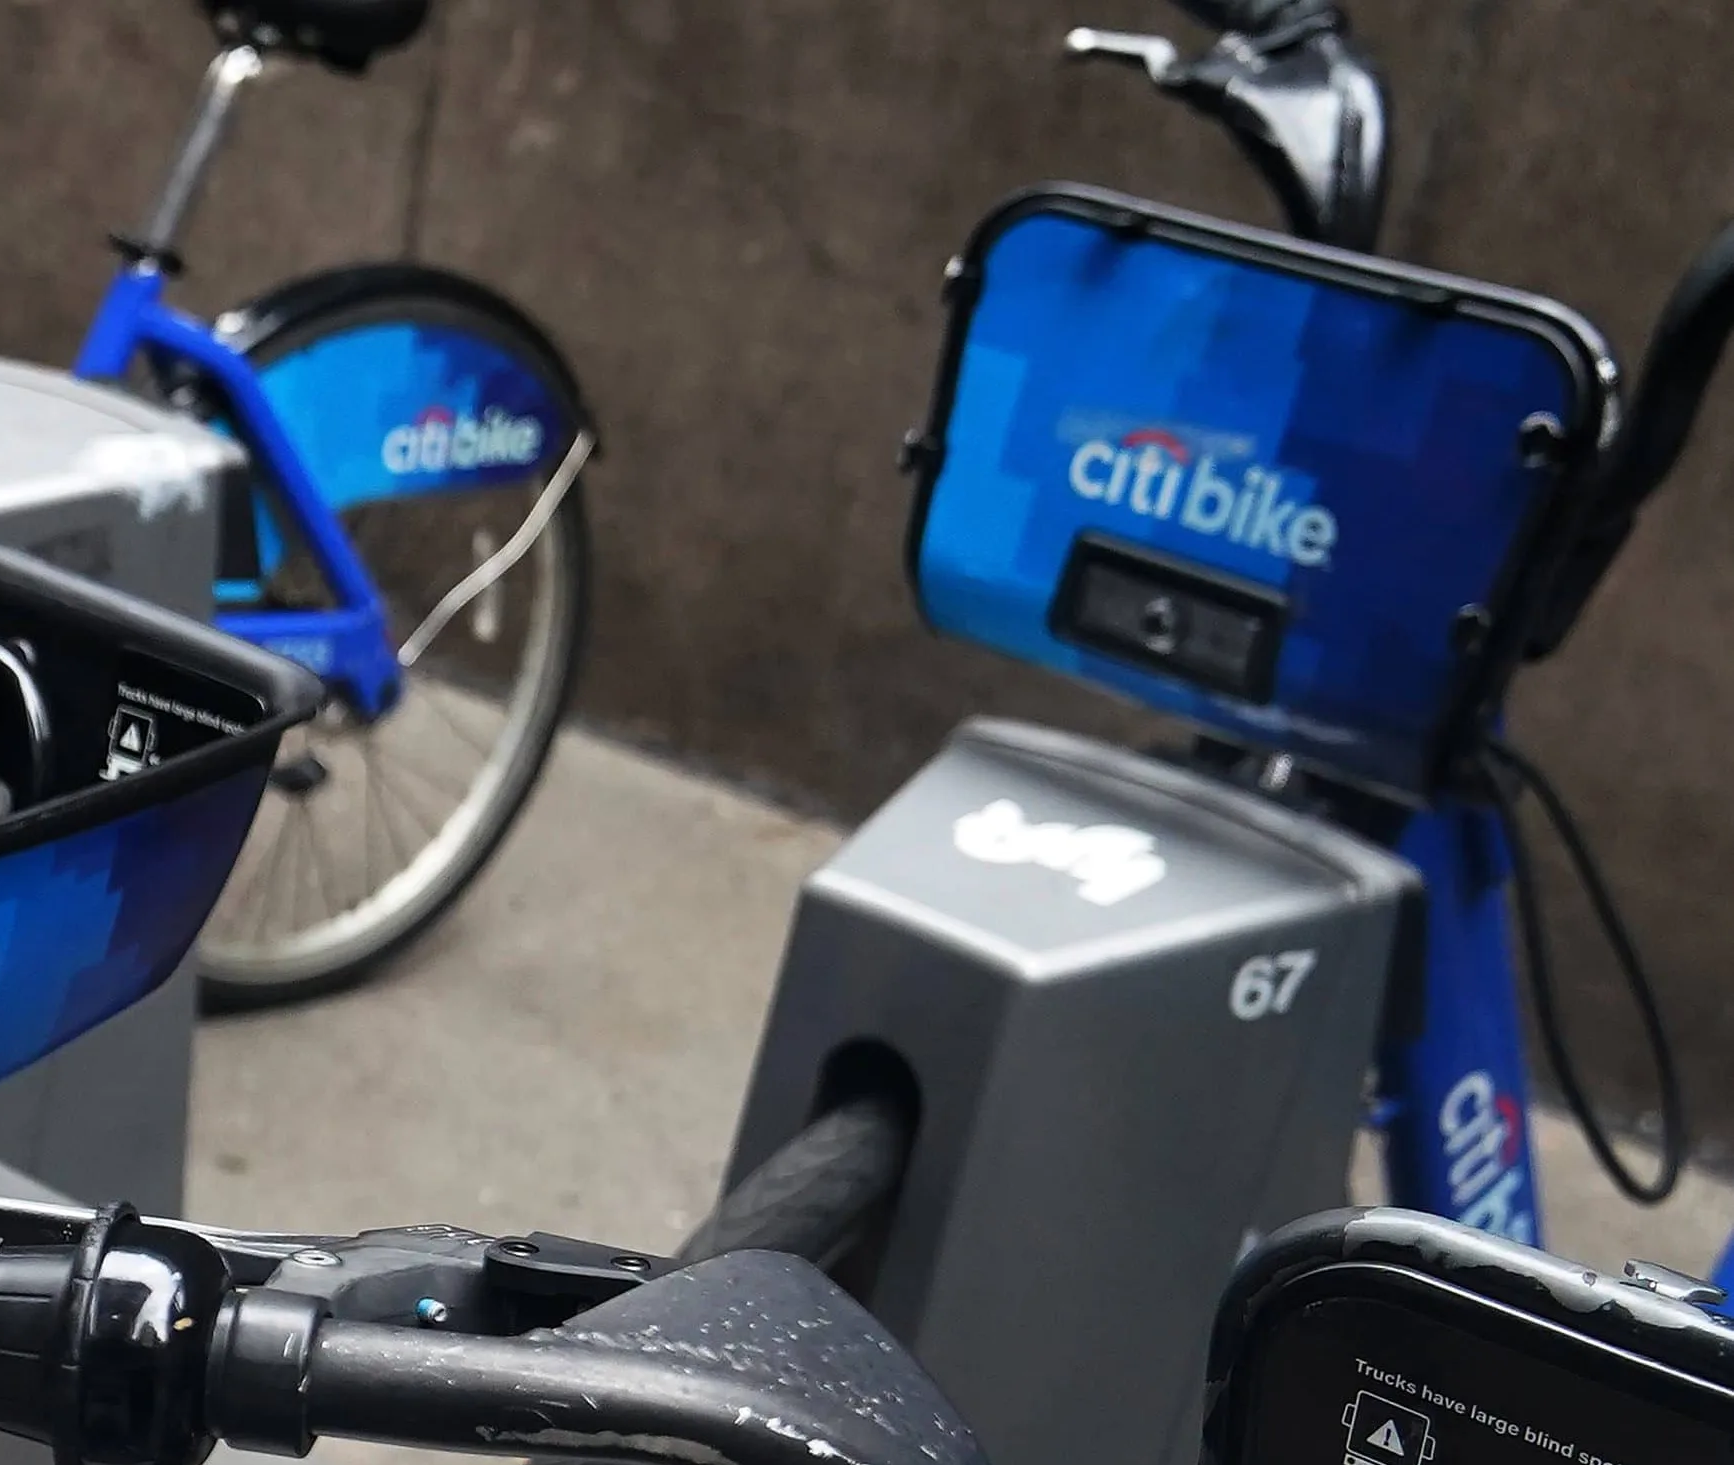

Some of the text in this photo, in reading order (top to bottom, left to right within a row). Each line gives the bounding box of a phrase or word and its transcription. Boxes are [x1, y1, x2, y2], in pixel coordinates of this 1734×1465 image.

[1069, 428, 1189, 520] citi
[1181, 455, 1337, 567] bike
[1229, 948, 1318, 1021] 67
[1439, 1069, 1520, 1206] citi
[1355, 1358, 1416, 1394] Trucks
[1422, 1385, 1466, 1414] have
[1470, 1405, 1520, 1437] large
[1524, 1426, 1574, 1459] blind
